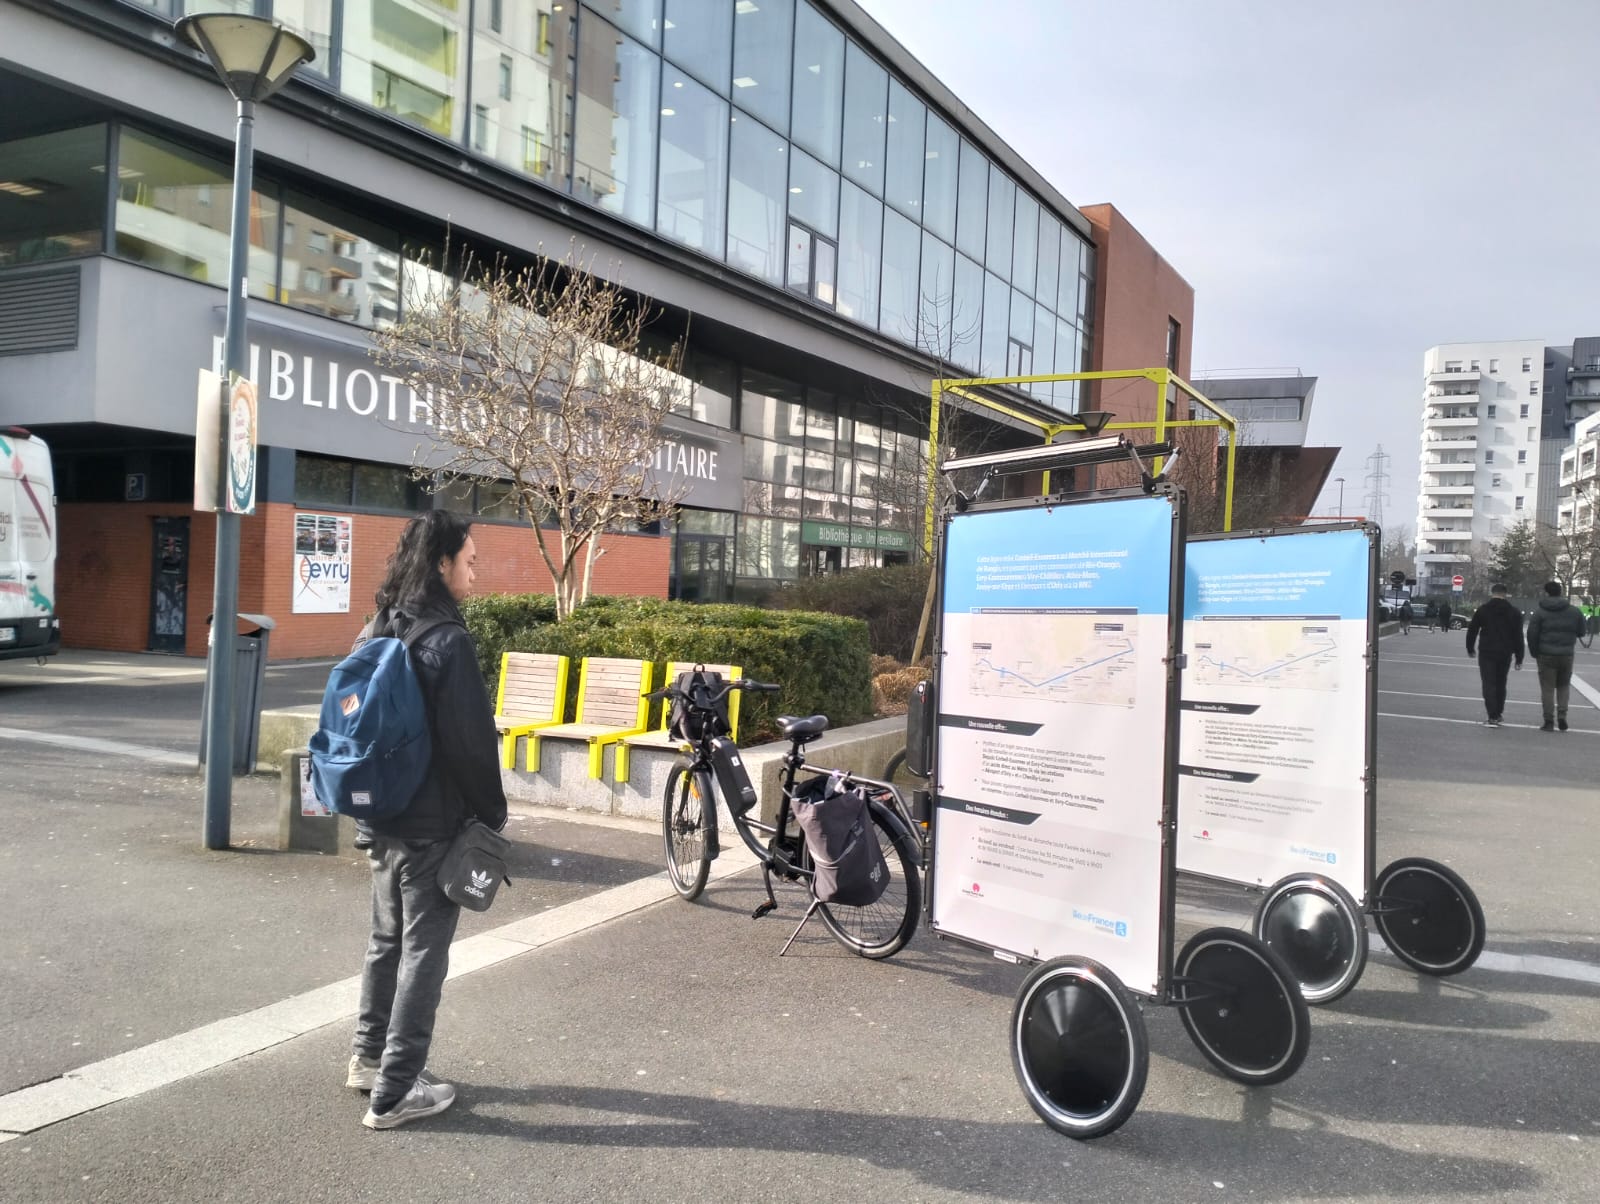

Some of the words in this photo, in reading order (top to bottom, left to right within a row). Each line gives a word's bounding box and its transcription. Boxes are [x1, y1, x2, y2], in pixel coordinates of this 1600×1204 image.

[212, 335, 530, 444] IBLIOTHEQ
[866, 532, 903, 546] Uniersitaire
[311, 562, 350, 584] evry
[464, 885, 486, 899] adidas
